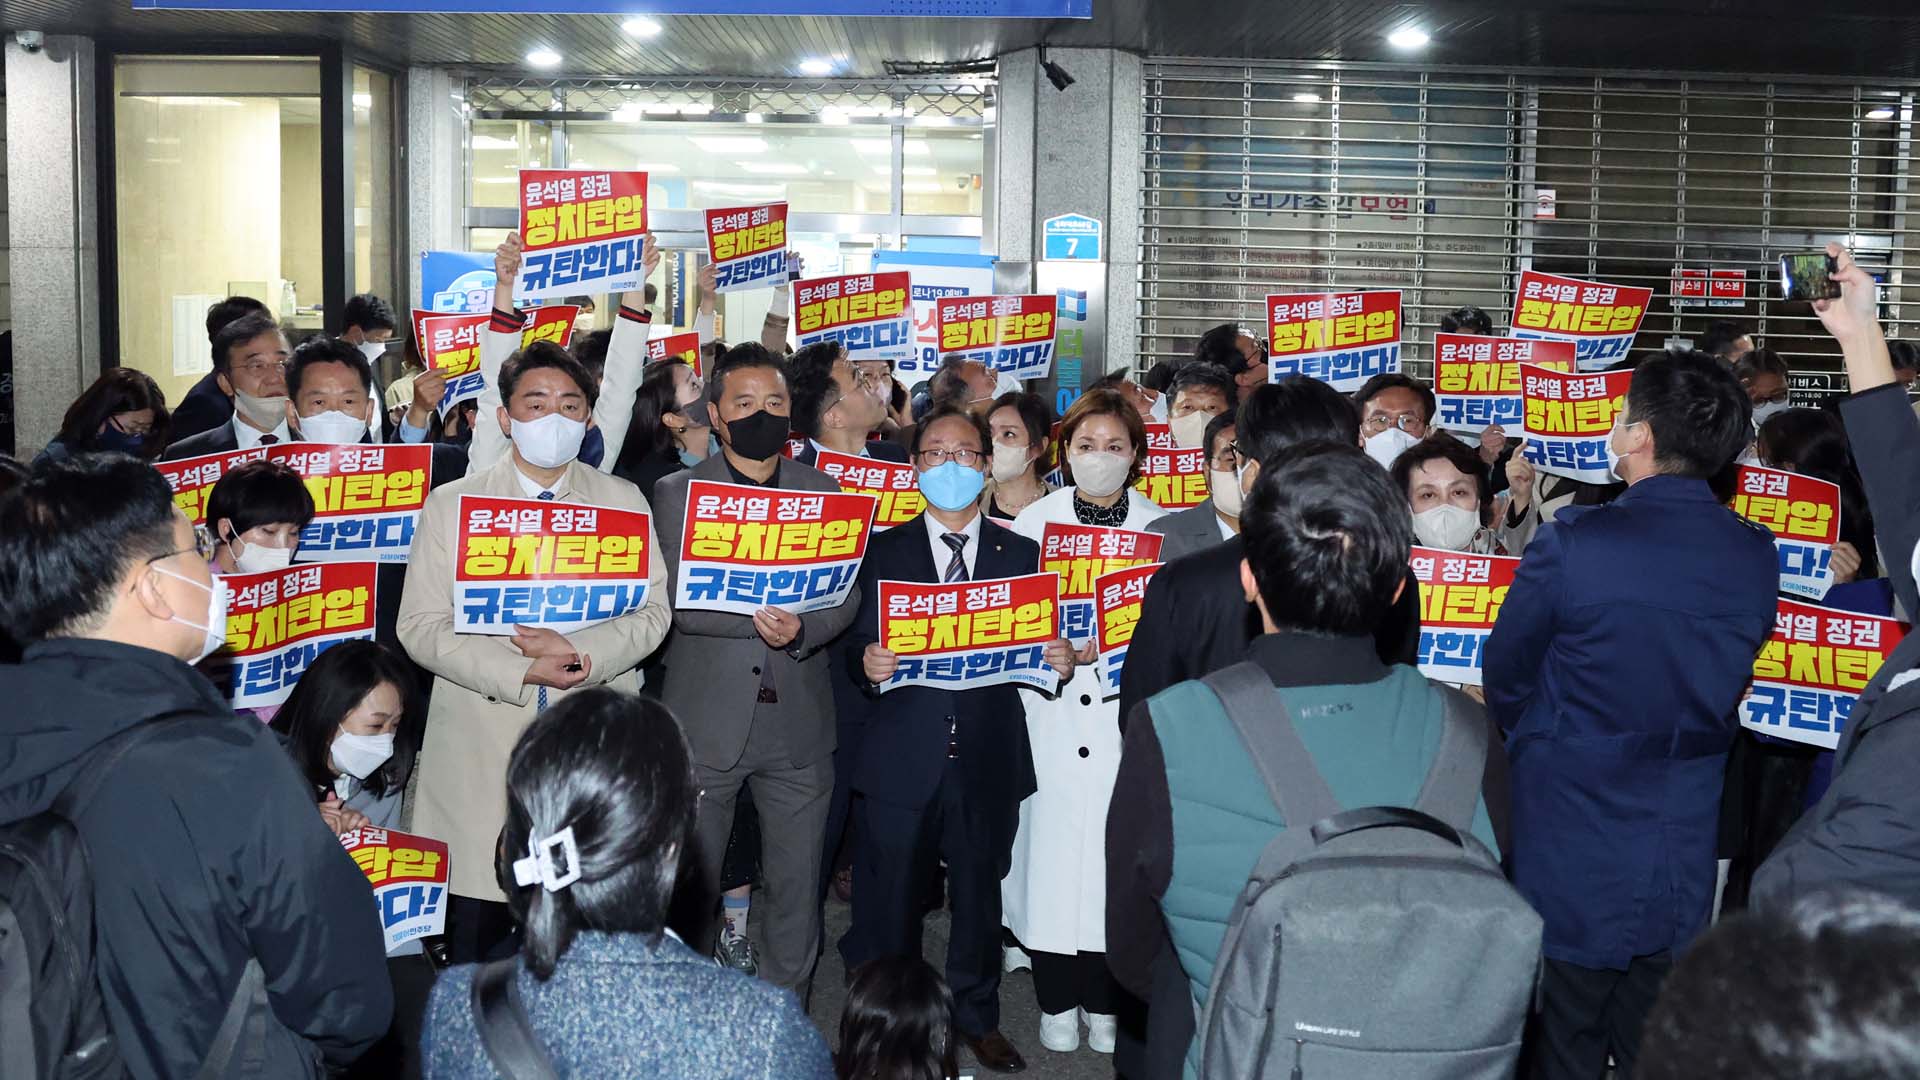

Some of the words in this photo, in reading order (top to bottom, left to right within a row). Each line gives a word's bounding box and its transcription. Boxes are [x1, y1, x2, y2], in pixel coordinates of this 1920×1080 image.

[526, 178, 576, 207] 윤석열
[580, 174, 612, 199] 정권
[525, 194, 643, 247] 정치탄압
[711, 211, 749, 233] 윤석열
[751, 207, 769, 225] 정권
[713, 219, 785, 260] 정치탄압
[1066, 238, 1079, 256] 7
[523, 238, 645, 292] 규탄한다!
[716, 250, 787, 289] 규탄한다!
[800, 281, 840, 305] 윤석열
[844, 275, 875, 295] 정권
[1524, 281, 1578, 303] 윤석열
[1582, 287, 1618, 305] 정권
[800, 288, 906, 331] 정치탄압
[943, 301, 987, 323] 윤석열
[992, 297, 1023, 317] 정권
[1274, 300, 1324, 323] 윤석열
[1329, 294, 1363, 316] 정권
[1518, 299, 1642, 332] 정치탄압
[434, 321, 481, 351] 윤석
[943, 312, 1053, 349] 정치탄압
[1274, 310, 1396, 353] 정치탄압
[1440, 343, 1491, 362] 윤석열
[1497, 341, 1533, 361] 정권
[1526, 376, 1562, 400] 윤석열
[1567, 375, 1607, 400] 정권
[338, 448, 385, 472] 정권
[1744, 471, 1790, 497] 정권
[469, 509, 543, 533] 윤석열
[551, 509, 597, 533] 정권
[696, 495, 770, 520] 윤석열
[777, 497, 825, 520] 정권
[464, 534, 643, 577] 정치탄압
[691, 518, 864, 561] 정치탄압
[1045, 534, 1093, 558] 윤석열
[1099, 534, 1137, 556] 정권
[283, 566, 322, 598] 정권
[686, 562, 858, 605] 규탄한다!
[1442, 558, 1491, 583] 정권
[463, 585, 646, 625] 규탄한다!
[888, 591, 958, 616] 윤석열
[965, 582, 1011, 611] 정권
[1103, 573, 1154, 610] 윤석
[887, 598, 1053, 653] 정치탄압
[1826, 618, 1881, 648] 정권
